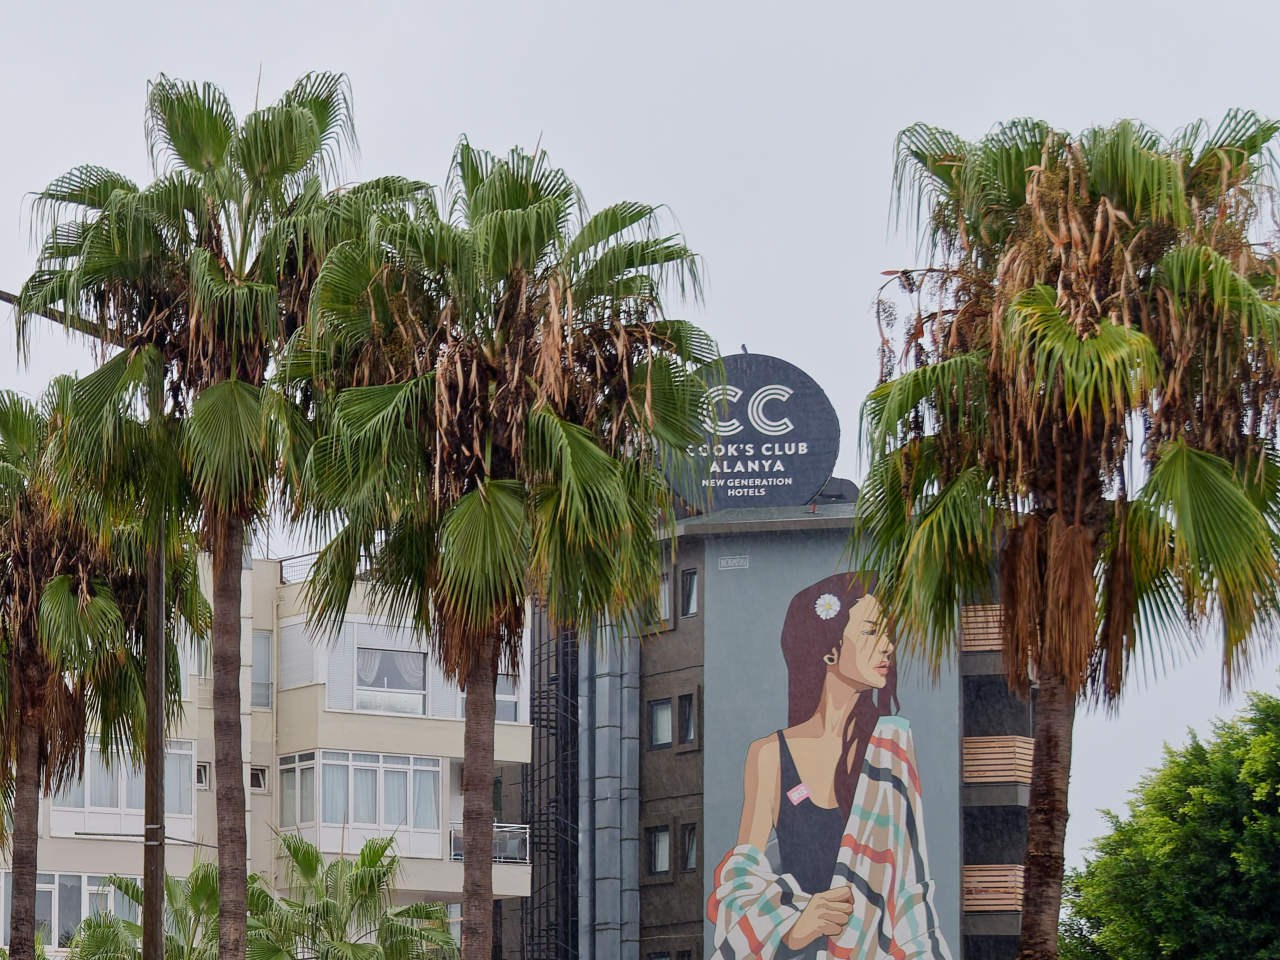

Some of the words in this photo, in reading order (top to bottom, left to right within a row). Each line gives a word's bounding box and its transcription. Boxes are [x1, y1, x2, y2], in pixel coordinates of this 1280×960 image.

[698, 384, 795, 436] CC
[761, 442, 809, 455] CLUB
[709, 460, 785, 473] ALANYA
[701, 479, 725, 487] NEW
[726, 478, 793, 487] GENERATION
[727, 488, 767, 497] HOTELS
